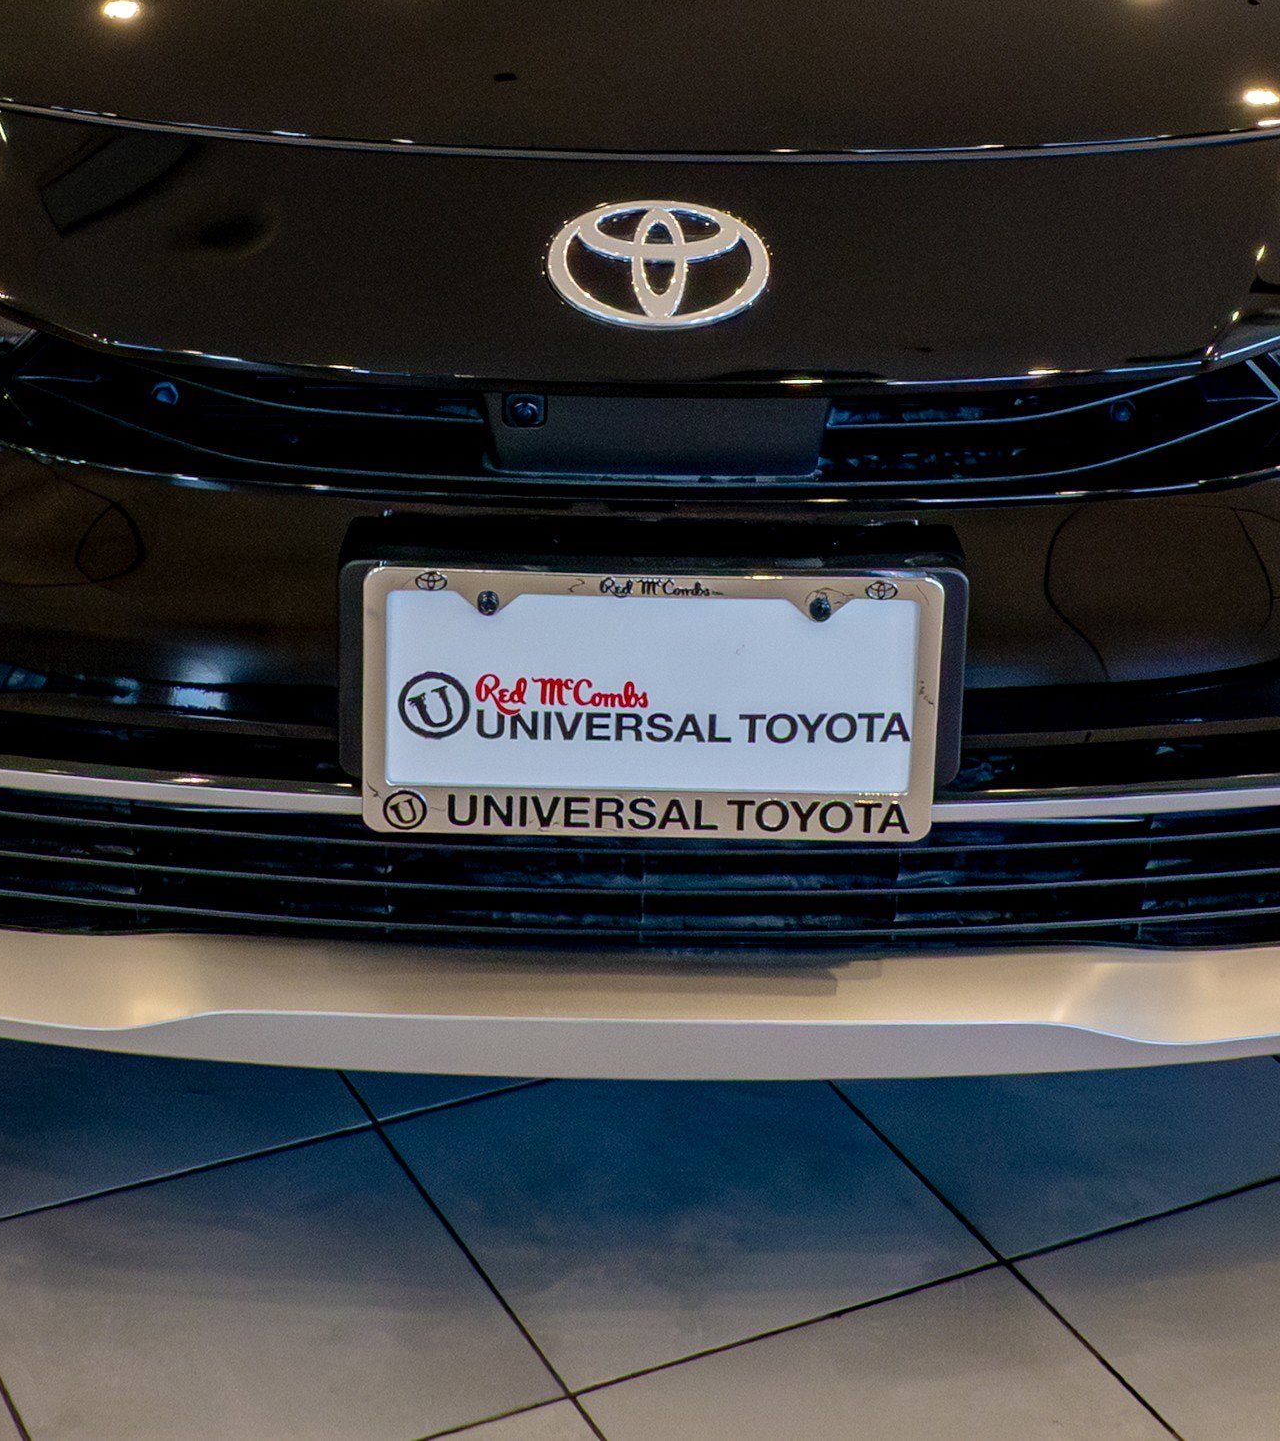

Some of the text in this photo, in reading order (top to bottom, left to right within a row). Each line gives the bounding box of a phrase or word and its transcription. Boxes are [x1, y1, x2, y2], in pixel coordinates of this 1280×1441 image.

[600, 576, 711, 598] Red McCombs
[476, 674, 649, 715] Red McCombs
[477, 709, 731, 743] UNIVERSAL
[739, 712, 911, 744] TOYOTA
[447, 794, 719, 831] UNIVERSAL
[729, 798, 911, 835] TOYOTA
